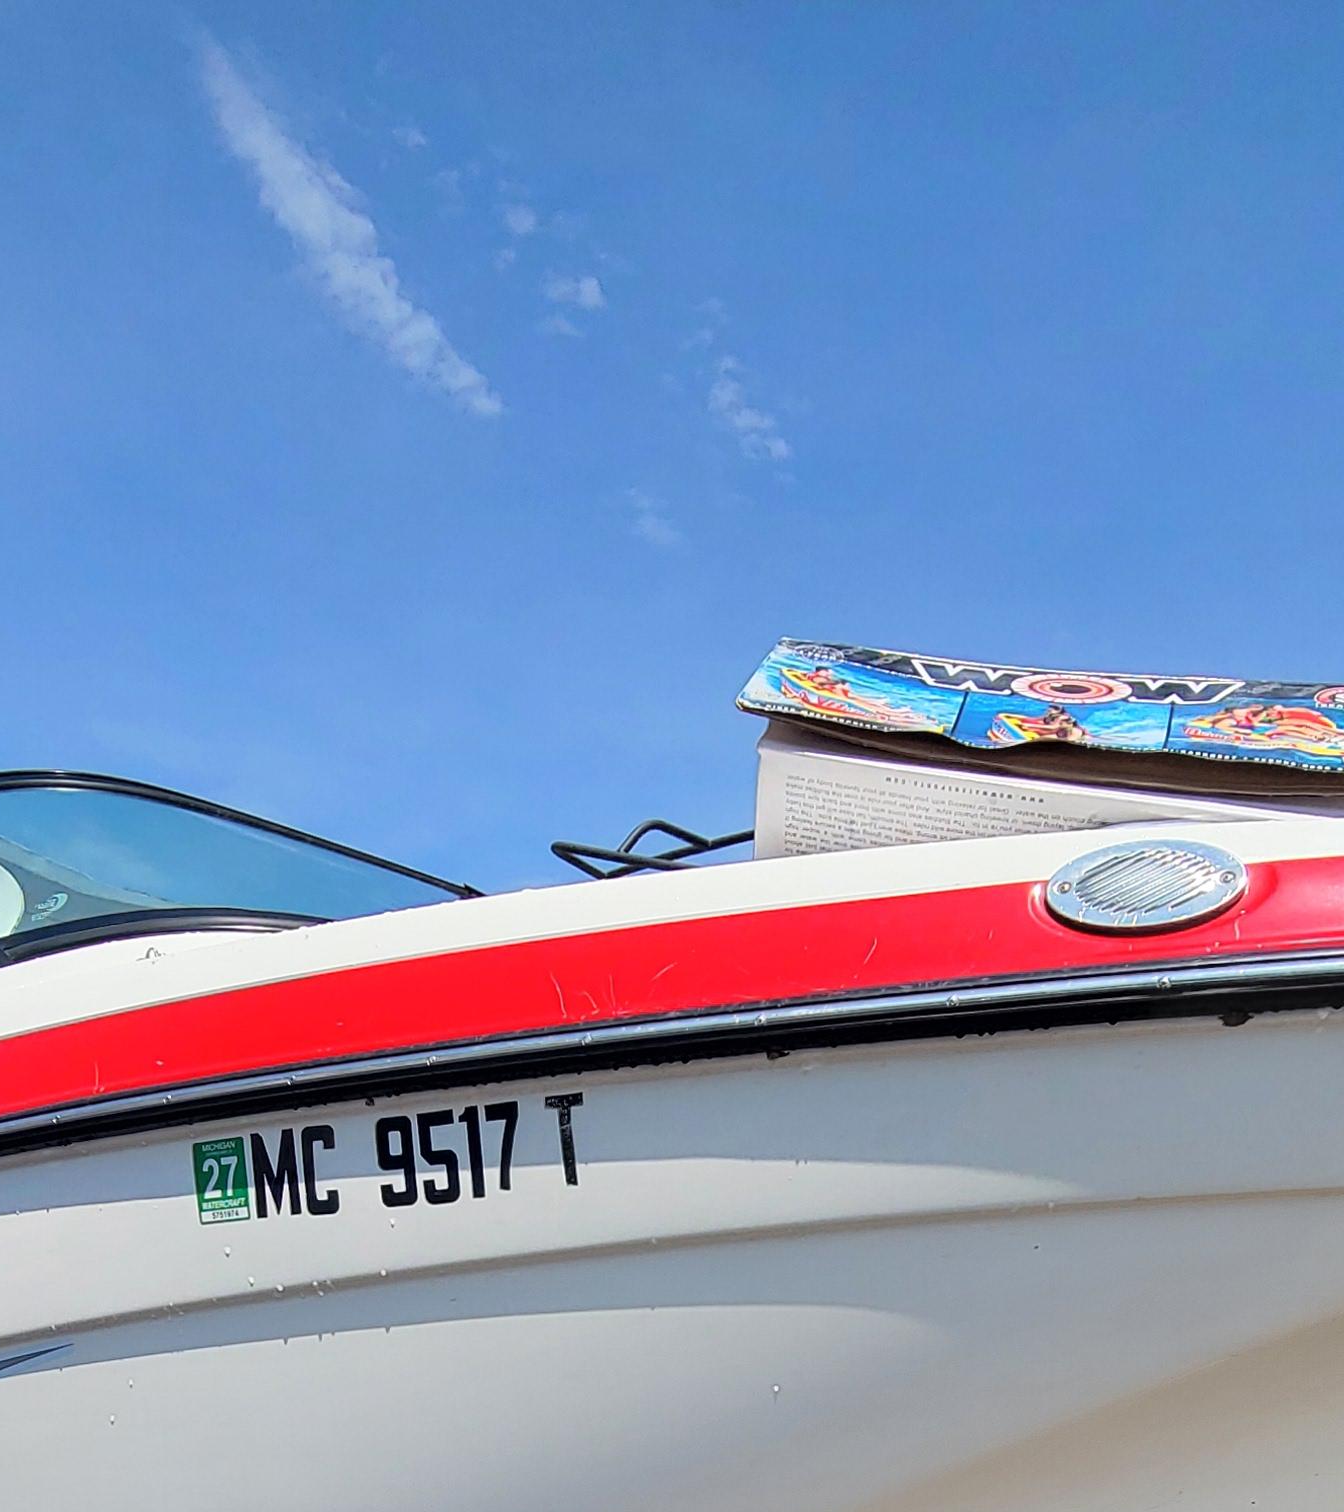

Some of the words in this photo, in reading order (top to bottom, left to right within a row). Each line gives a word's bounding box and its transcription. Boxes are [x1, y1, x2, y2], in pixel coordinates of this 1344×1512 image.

[910, 657, 1246, 706] WOW
[201, 1141, 236, 1152] MICHIGAN
[250, 1124, 341, 1219] MC
[375, 1100, 519, 1208] 9517
[544, 1091, 585, 1188] T
[202, 1156, 239, 1200] 27
[201, 1198, 246, 1210] WATERCRAFT
